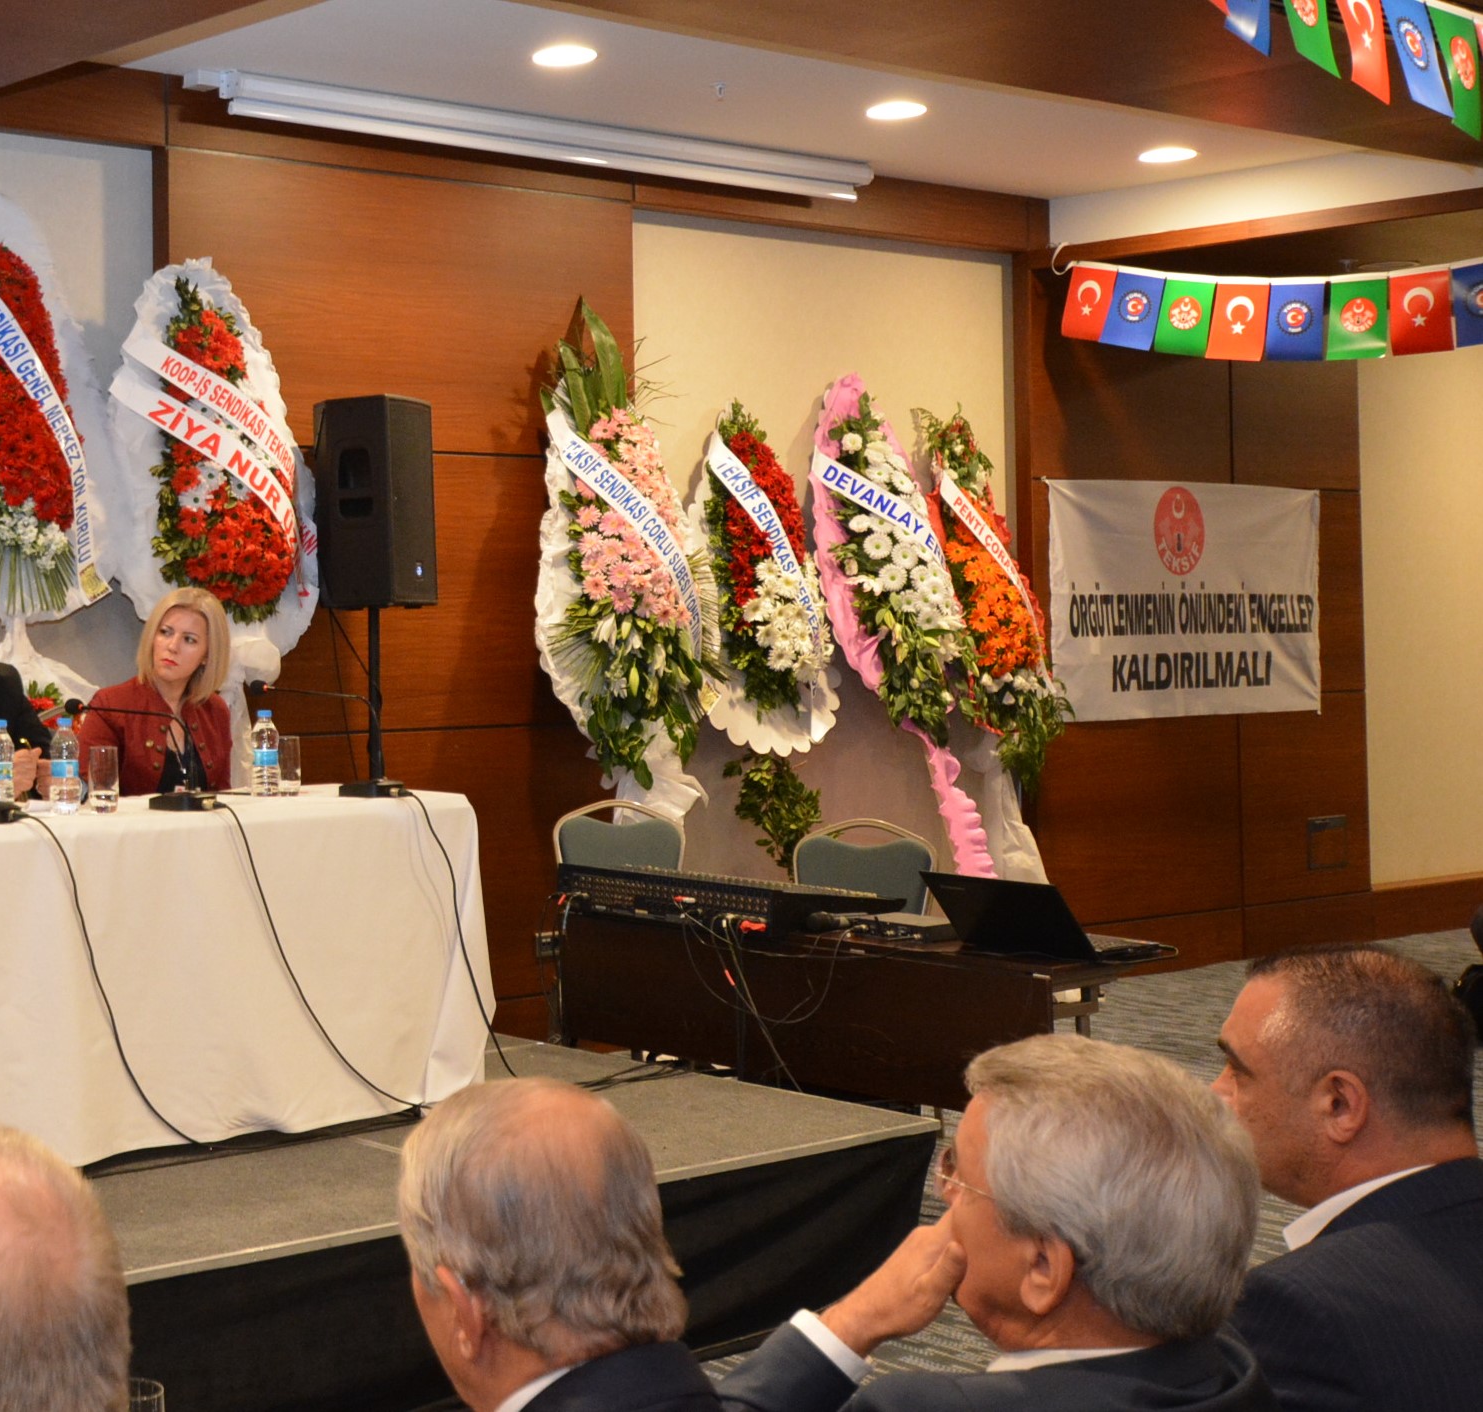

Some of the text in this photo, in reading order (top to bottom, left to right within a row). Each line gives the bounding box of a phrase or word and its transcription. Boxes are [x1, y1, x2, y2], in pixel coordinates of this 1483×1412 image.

[160, 356, 212, 399] KOOP-İŞ
[209, 383, 268, 437] SENDİKASI
[16, 358, 53, 406] GENEL
[44, 404, 81, 466] MERKEZ
[75, 501, 92, 563] KURULU
[148, 400, 222, 457] ZİYA
[227, 449, 282, 512] NUR
[594, 469, 650, 523] SENDİKASI
[640, 517, 675, 556] ÇORLU
[668, 552, 695, 595] ŞUBESİ
[716, 456, 761, 501] TEKSİF
[751, 502, 797, 576] SENDİKASI
[823, 464, 924, 534] DEVANLAY
[953, 496, 986, 535] PENTİ
[1069, 581, 1175, 638] ÖRGÜTLENMENİN
[1179, 581, 1247, 635] ÖNÜNDEKİ
[1112, 651, 1272, 692] KALDIRILMALI
